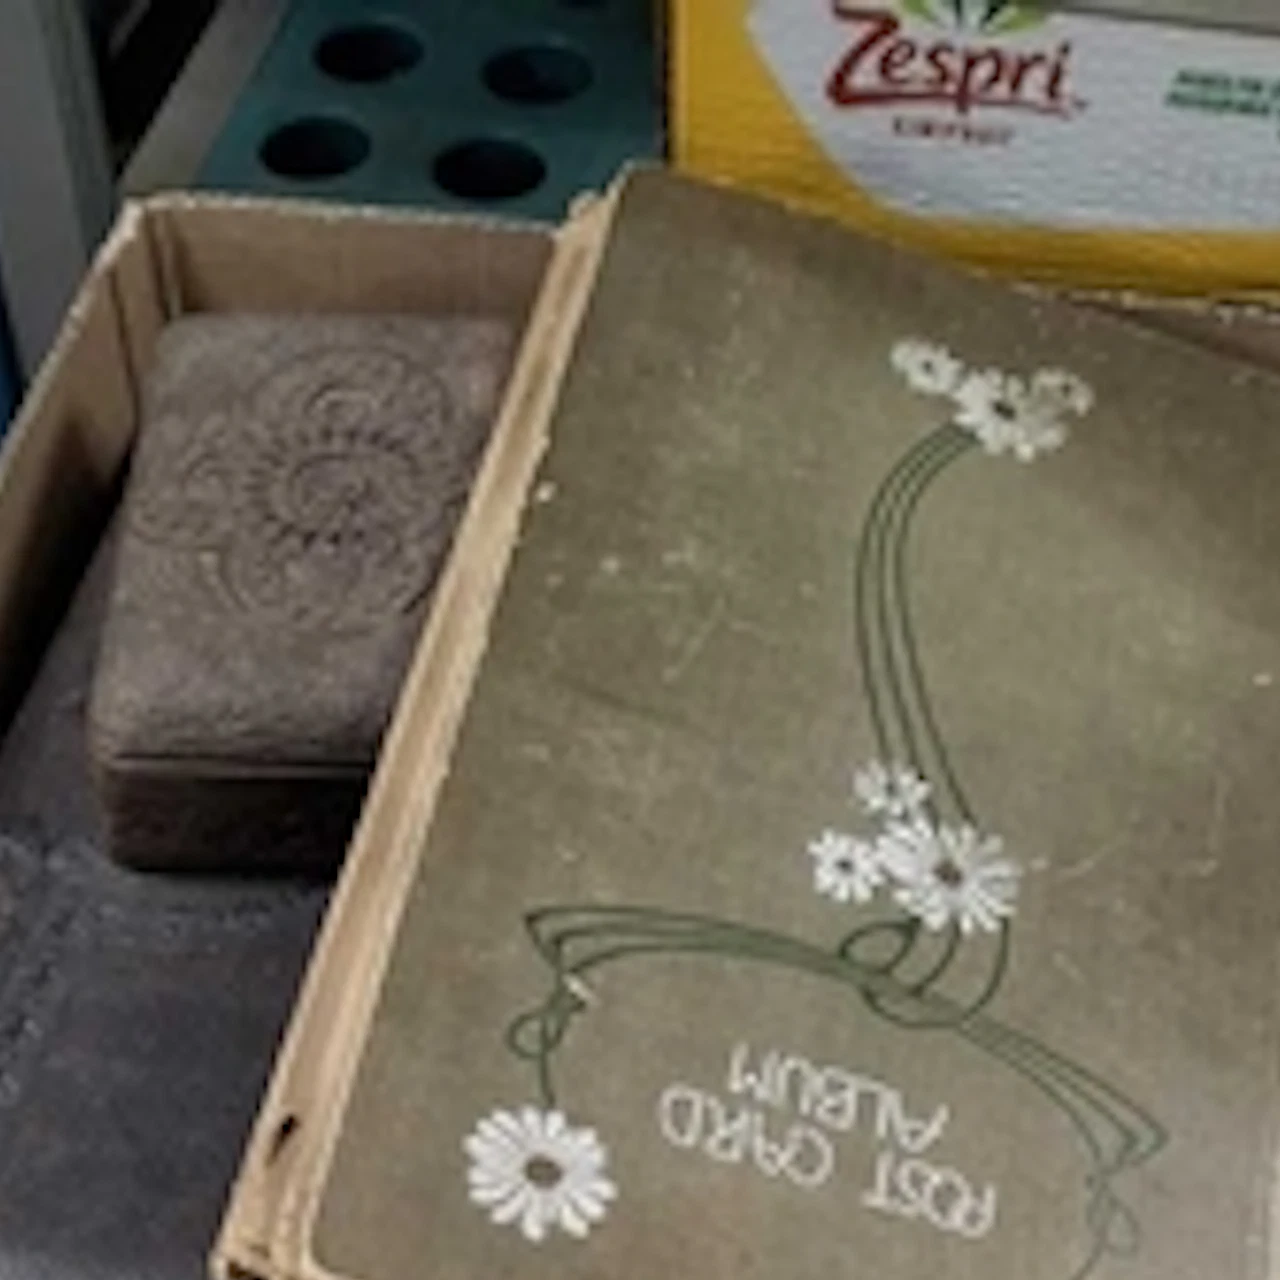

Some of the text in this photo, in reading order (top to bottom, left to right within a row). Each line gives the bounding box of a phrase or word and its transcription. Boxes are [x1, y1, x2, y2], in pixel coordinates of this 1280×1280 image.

[826, 0, 1074, 121] Zespri
[728, 1041, 951, 1154] ALBUM
[658, 1081, 998, 1239] POST CARD
